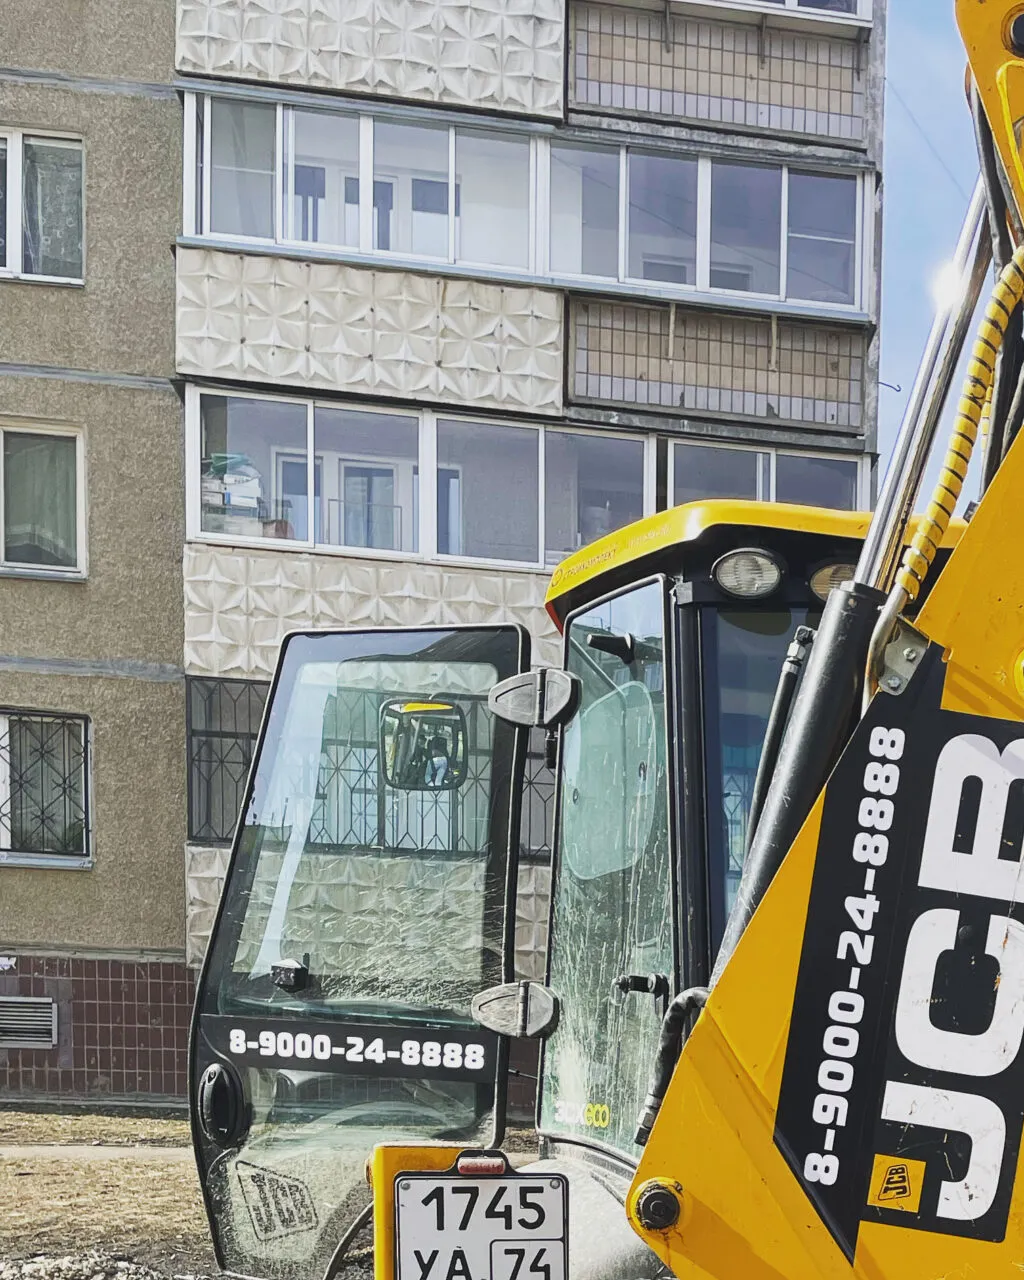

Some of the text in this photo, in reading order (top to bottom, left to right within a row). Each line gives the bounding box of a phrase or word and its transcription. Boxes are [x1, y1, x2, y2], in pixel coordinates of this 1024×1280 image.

[803, 726, 906, 1187] 8-9000-24-8888
[229, 1028, 485, 1070] 8-9000-24-8888
[882, 1166, 908, 1196] JCB
[421, 1186, 546, 1231] 1745
